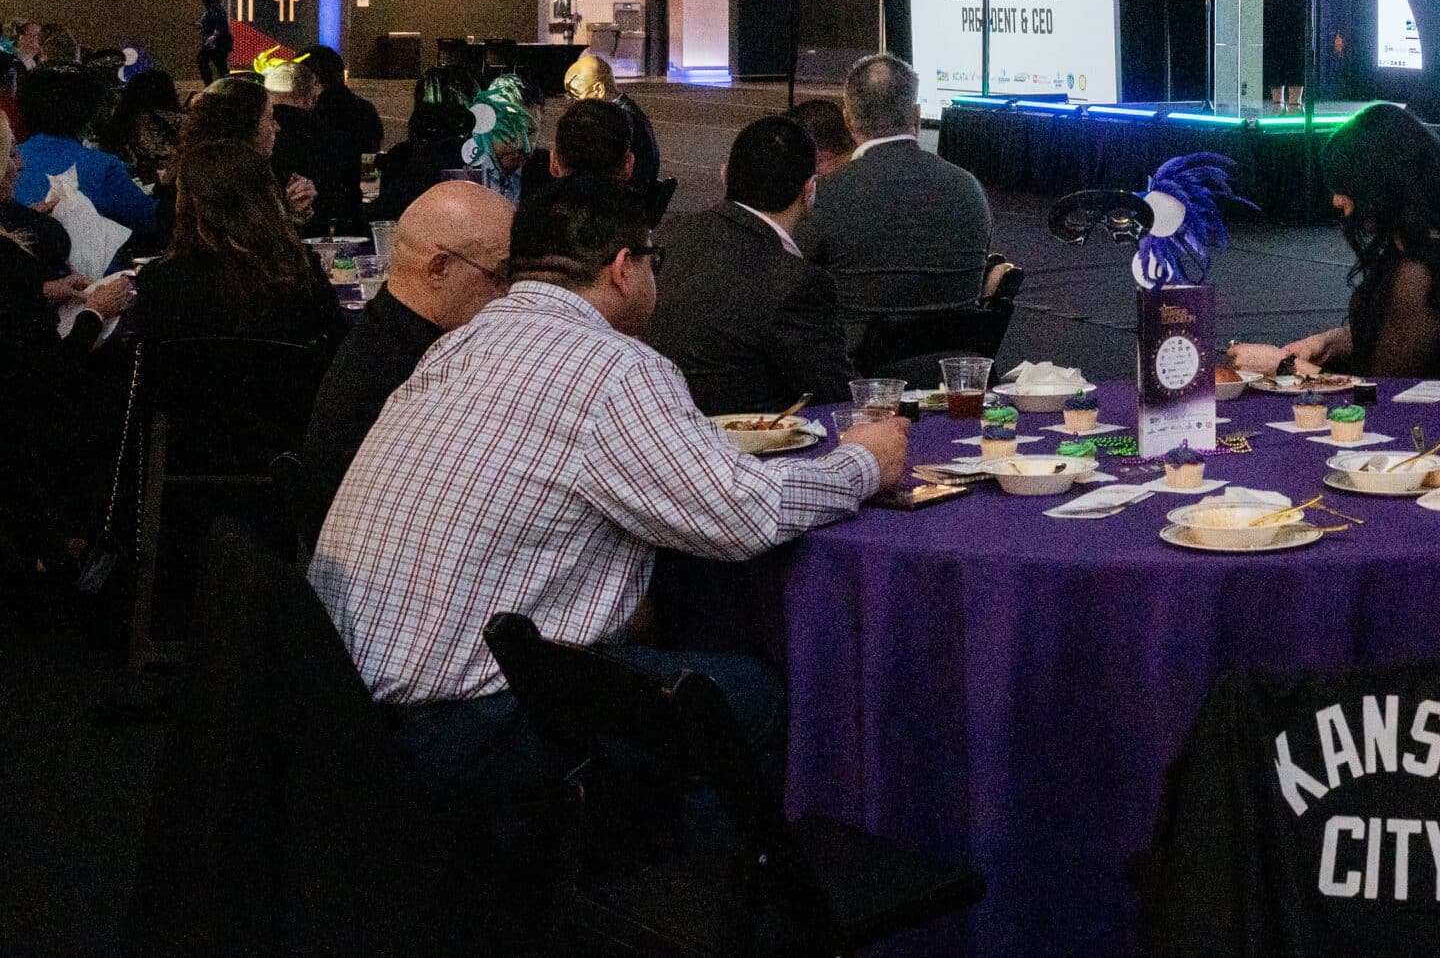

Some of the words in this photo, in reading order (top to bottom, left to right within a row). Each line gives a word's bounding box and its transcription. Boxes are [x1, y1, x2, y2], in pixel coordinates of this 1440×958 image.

[962, 7, 1016, 34] PREDENT
[1021, 8, 1028, 34] &
[1032, 8, 1053, 35] CEO
